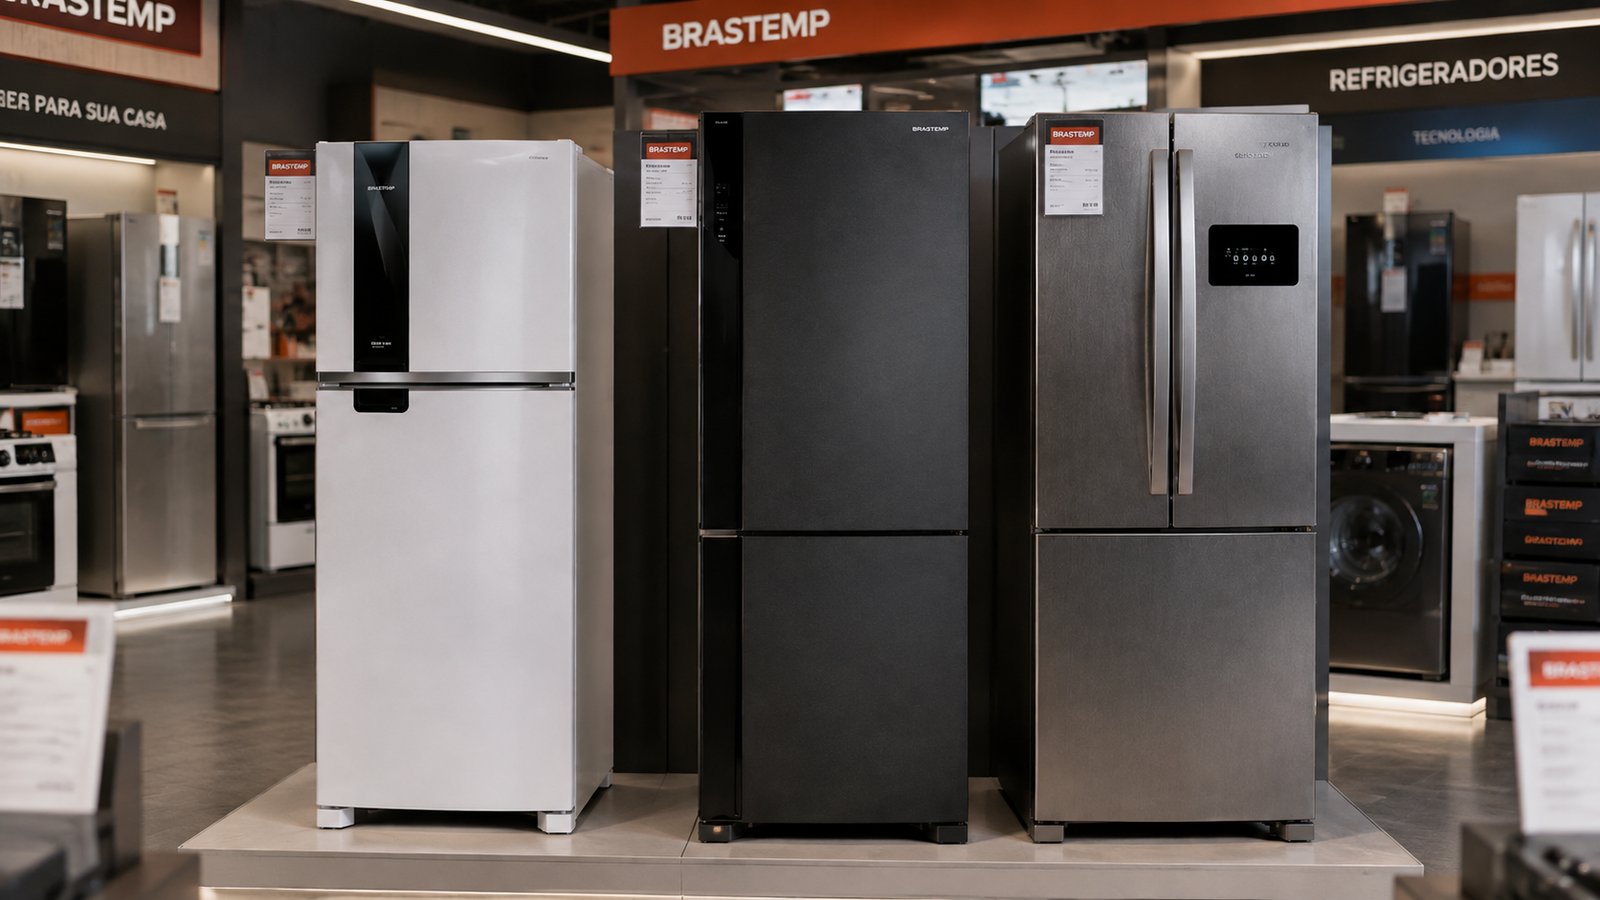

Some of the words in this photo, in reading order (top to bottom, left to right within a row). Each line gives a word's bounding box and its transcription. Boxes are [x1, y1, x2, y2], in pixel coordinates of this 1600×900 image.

[5, 0, 176, 33] STEMP
[662, 9, 830, 50] BRASTEMP
[1329, 53, 1559, 92] REFRIGERADORES
[35, 94, 82, 119] PARA
[85, 101, 120, 124] SUA
[123, 107, 167, 131] CASA
[1052, 130, 1095, 138] BRASTEMP
[1412, 126, 1500, 145] TECNOLOGIA
[1529, 437, 1584, 447] BRASTEMP
[1525, 499, 1583, 510] BRASTEMP
[1523, 573, 1578, 585] BRASTEMP
